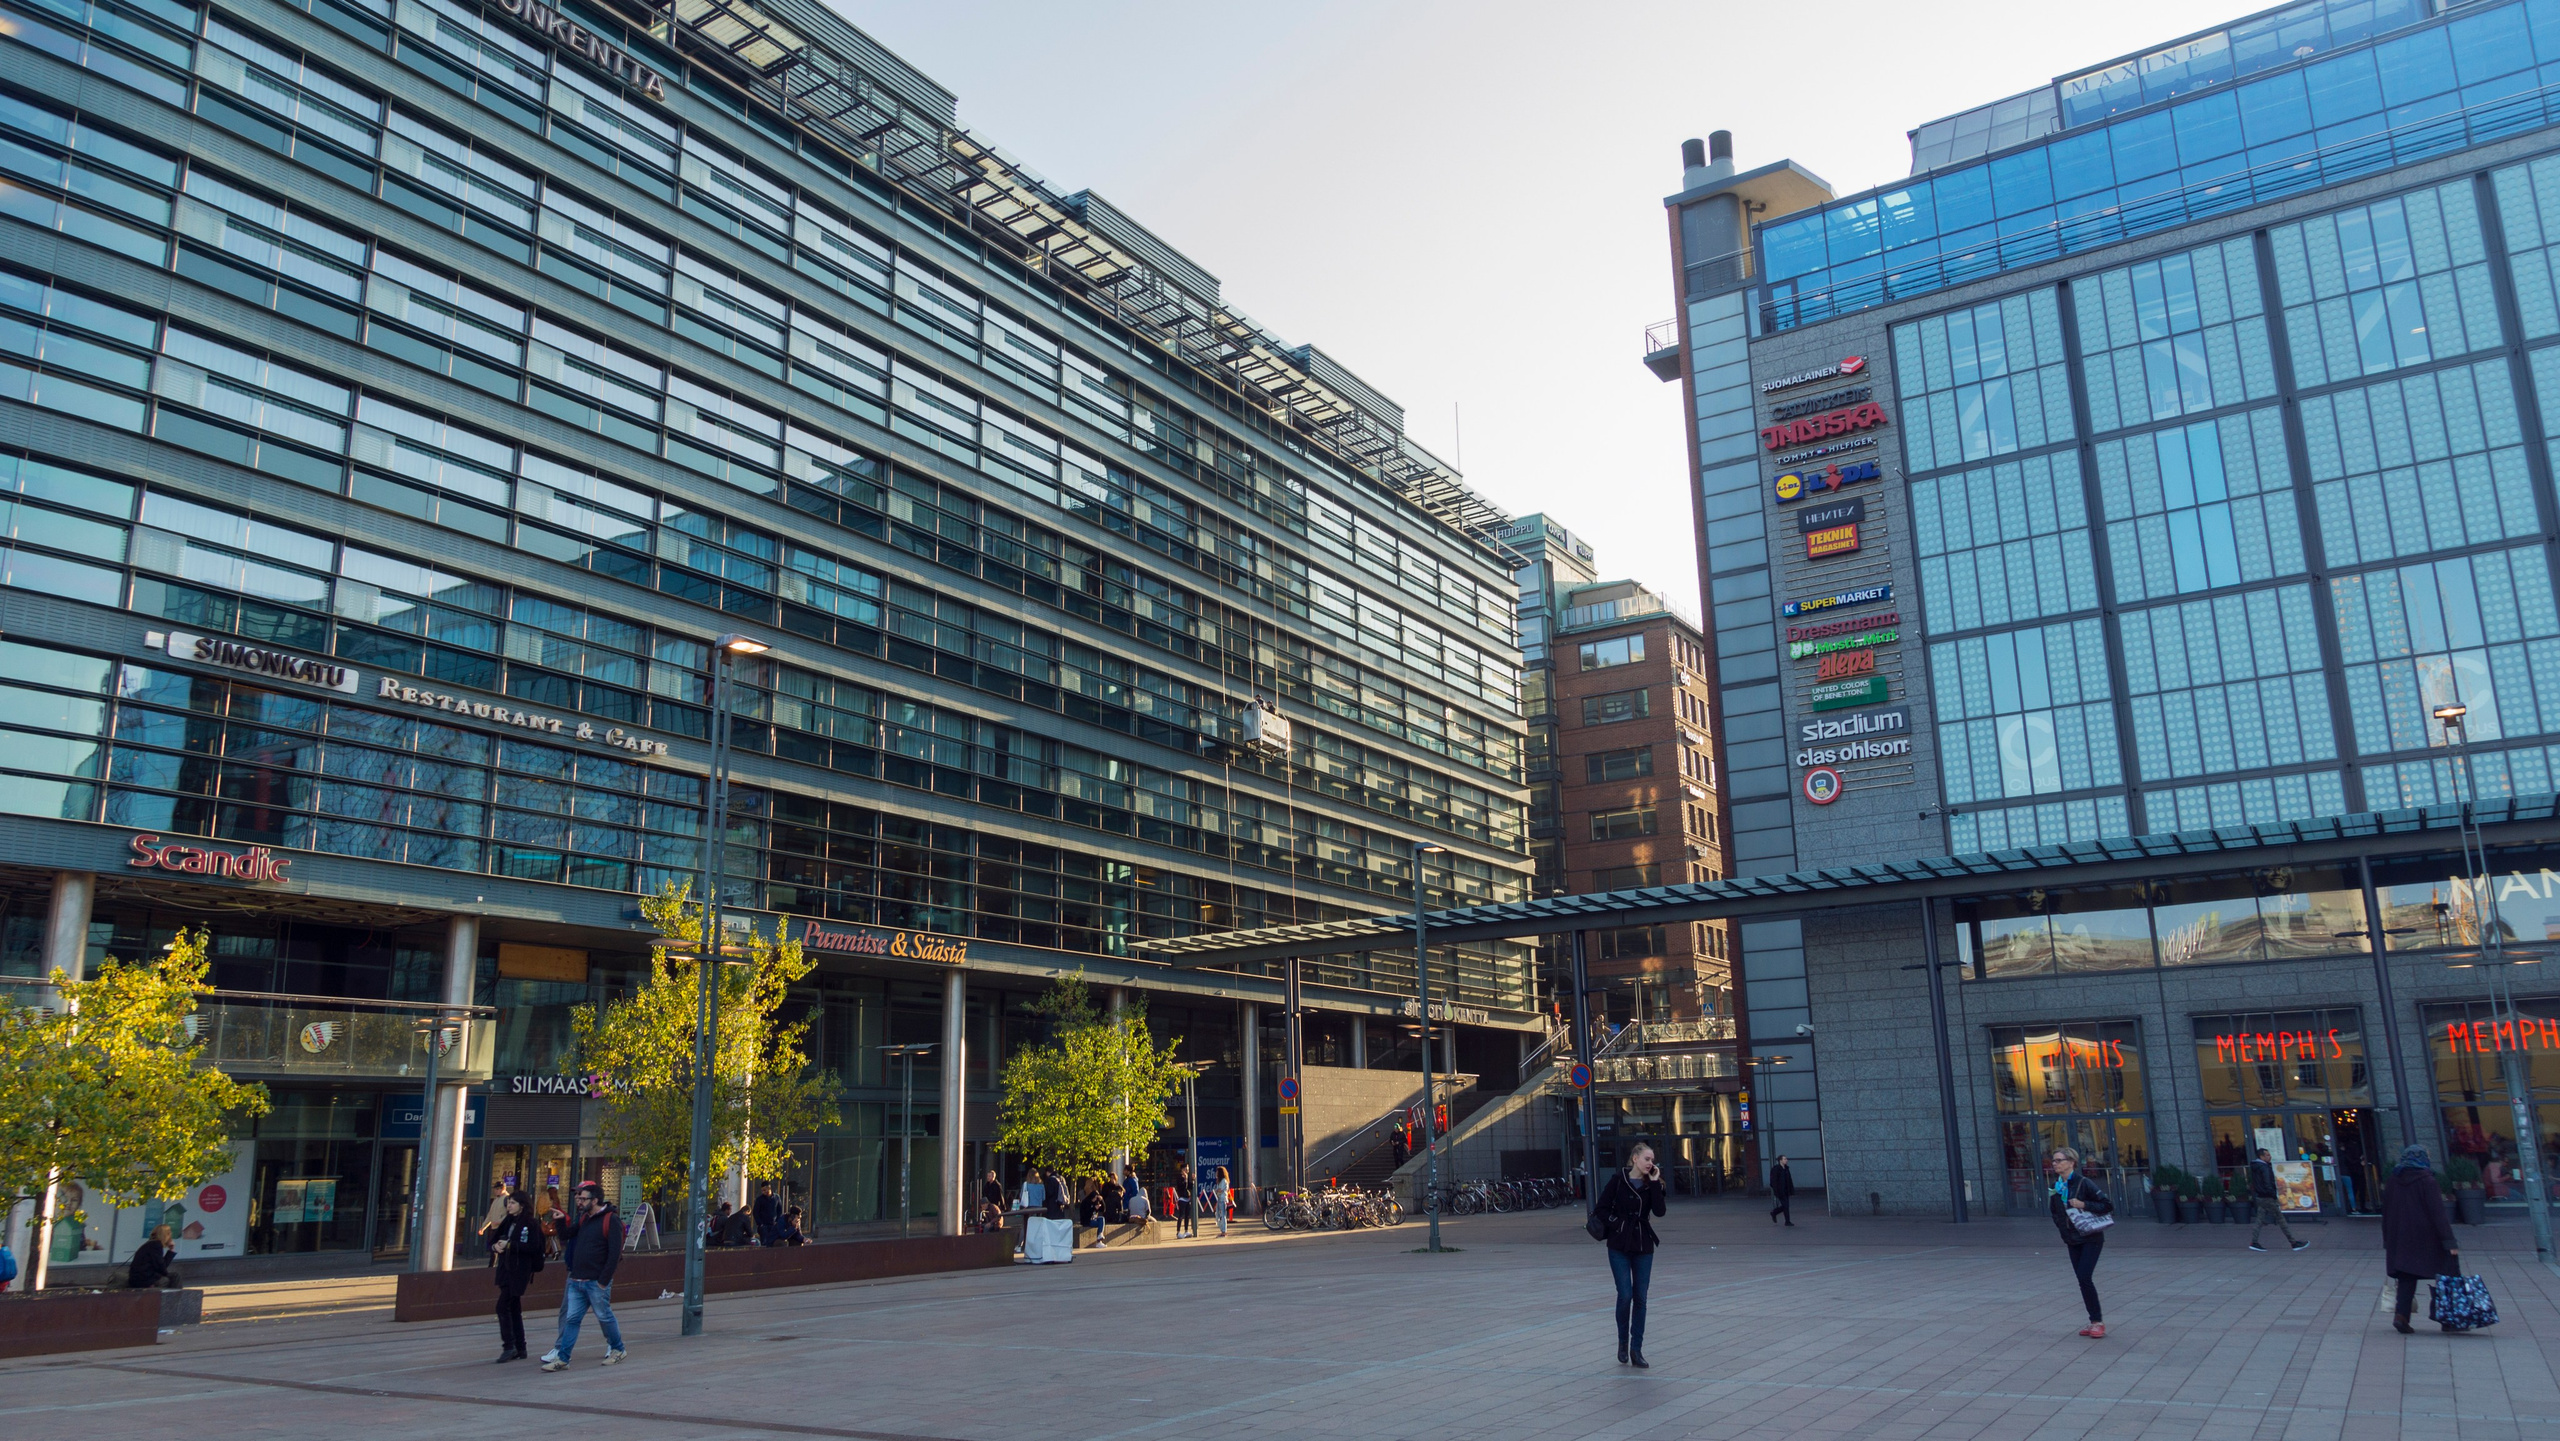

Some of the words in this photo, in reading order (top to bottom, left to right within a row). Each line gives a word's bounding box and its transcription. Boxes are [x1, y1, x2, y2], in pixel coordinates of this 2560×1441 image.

[497, 0, 665, 102] ONKENTTÄ
[2072, 43, 2201, 95] MAXINE
[1761, 366, 1837, 392] SUOMALAINEN
[1772, 396, 1826, 420] CALVIN
[1777, 450, 1814, 464] TOMMY
[1829, 436, 1873, 452] HILFIGER
[1806, 506, 1854, 524] HEMTEX
[1809, 527, 1853, 545] TEKNIK
[1811, 540, 1855, 555] MAGASINET
[1785, 604, 1794, 613] K
[1801, 588, 1883, 611] SUPERMARKET
[1786, 612, 1900, 643] Dressmann
[1817, 636, 1855, 653] Musti
[194, 637, 345, 687] SIMONKATU
[1818, 649, 1874, 678] alepa
[1812, 684, 1838, 694] UNITED
[1841, 680, 1869, 690] COLORS
[1813, 693, 1823, 701] OF
[576, 722, 594, 741] &
[1802, 712, 1902, 741] stadium
[1796, 748, 1837, 767] clas
[1840, 740, 1907, 760] ohlson
[127, 834, 291, 882] Scandic
[802, 921, 887, 954] Punnitse
[890, 932, 908, 957] &
[910, 933, 967, 964] Säästä
[2013, 1039, 2124, 1072] MEMPHIS
[2216, 1029, 2342, 1063] MEMPHIS
[1741, 1112, 1749, 1120] M
[1198, 1154, 1231, 1167] Souvenir
